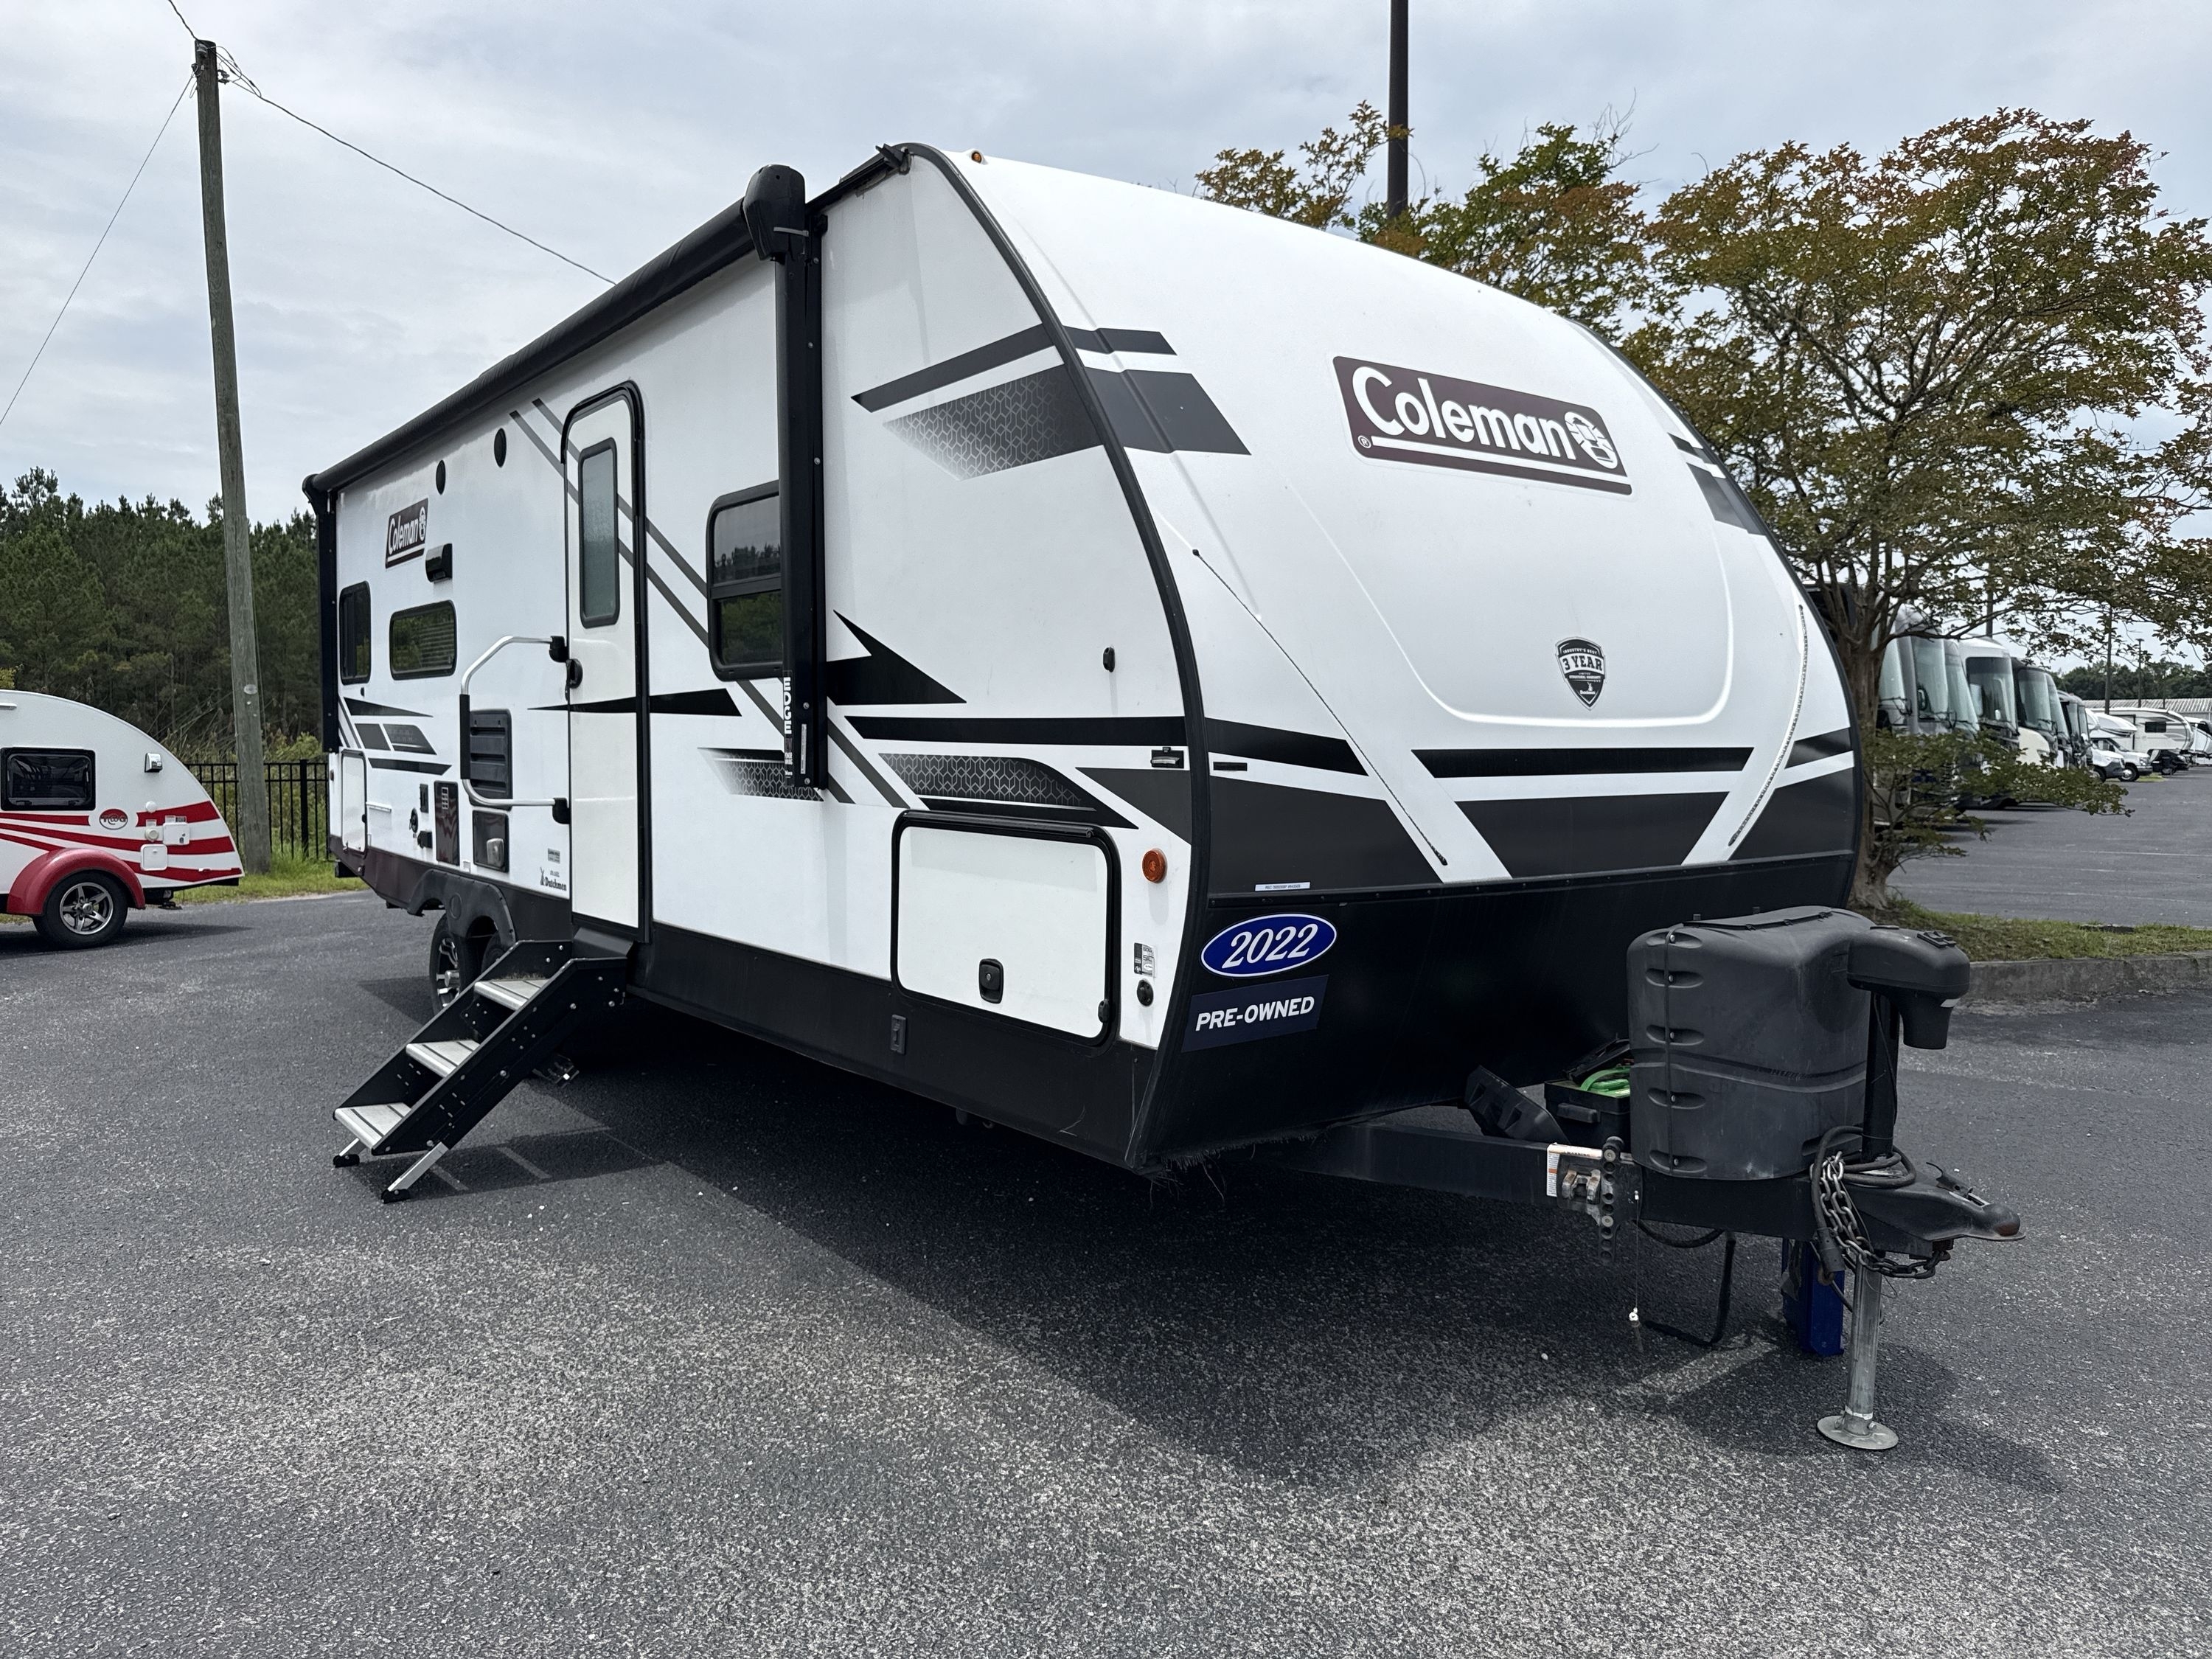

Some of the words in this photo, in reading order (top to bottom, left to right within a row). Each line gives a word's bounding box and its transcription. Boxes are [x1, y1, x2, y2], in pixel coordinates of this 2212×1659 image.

[1352, 366, 1577, 461] Coleman
[388, 515, 419, 555] Coleman
[1562, 658, 1571, 671] 3
[1571, 655, 1603, 672] YEAR
[783, 677, 792, 734] EDGE
[545, 876, 567, 891] Dutchmen
[1221, 923, 1318, 970] 2022
[1195, 996, 1315, 1032] PRE-OWNED
